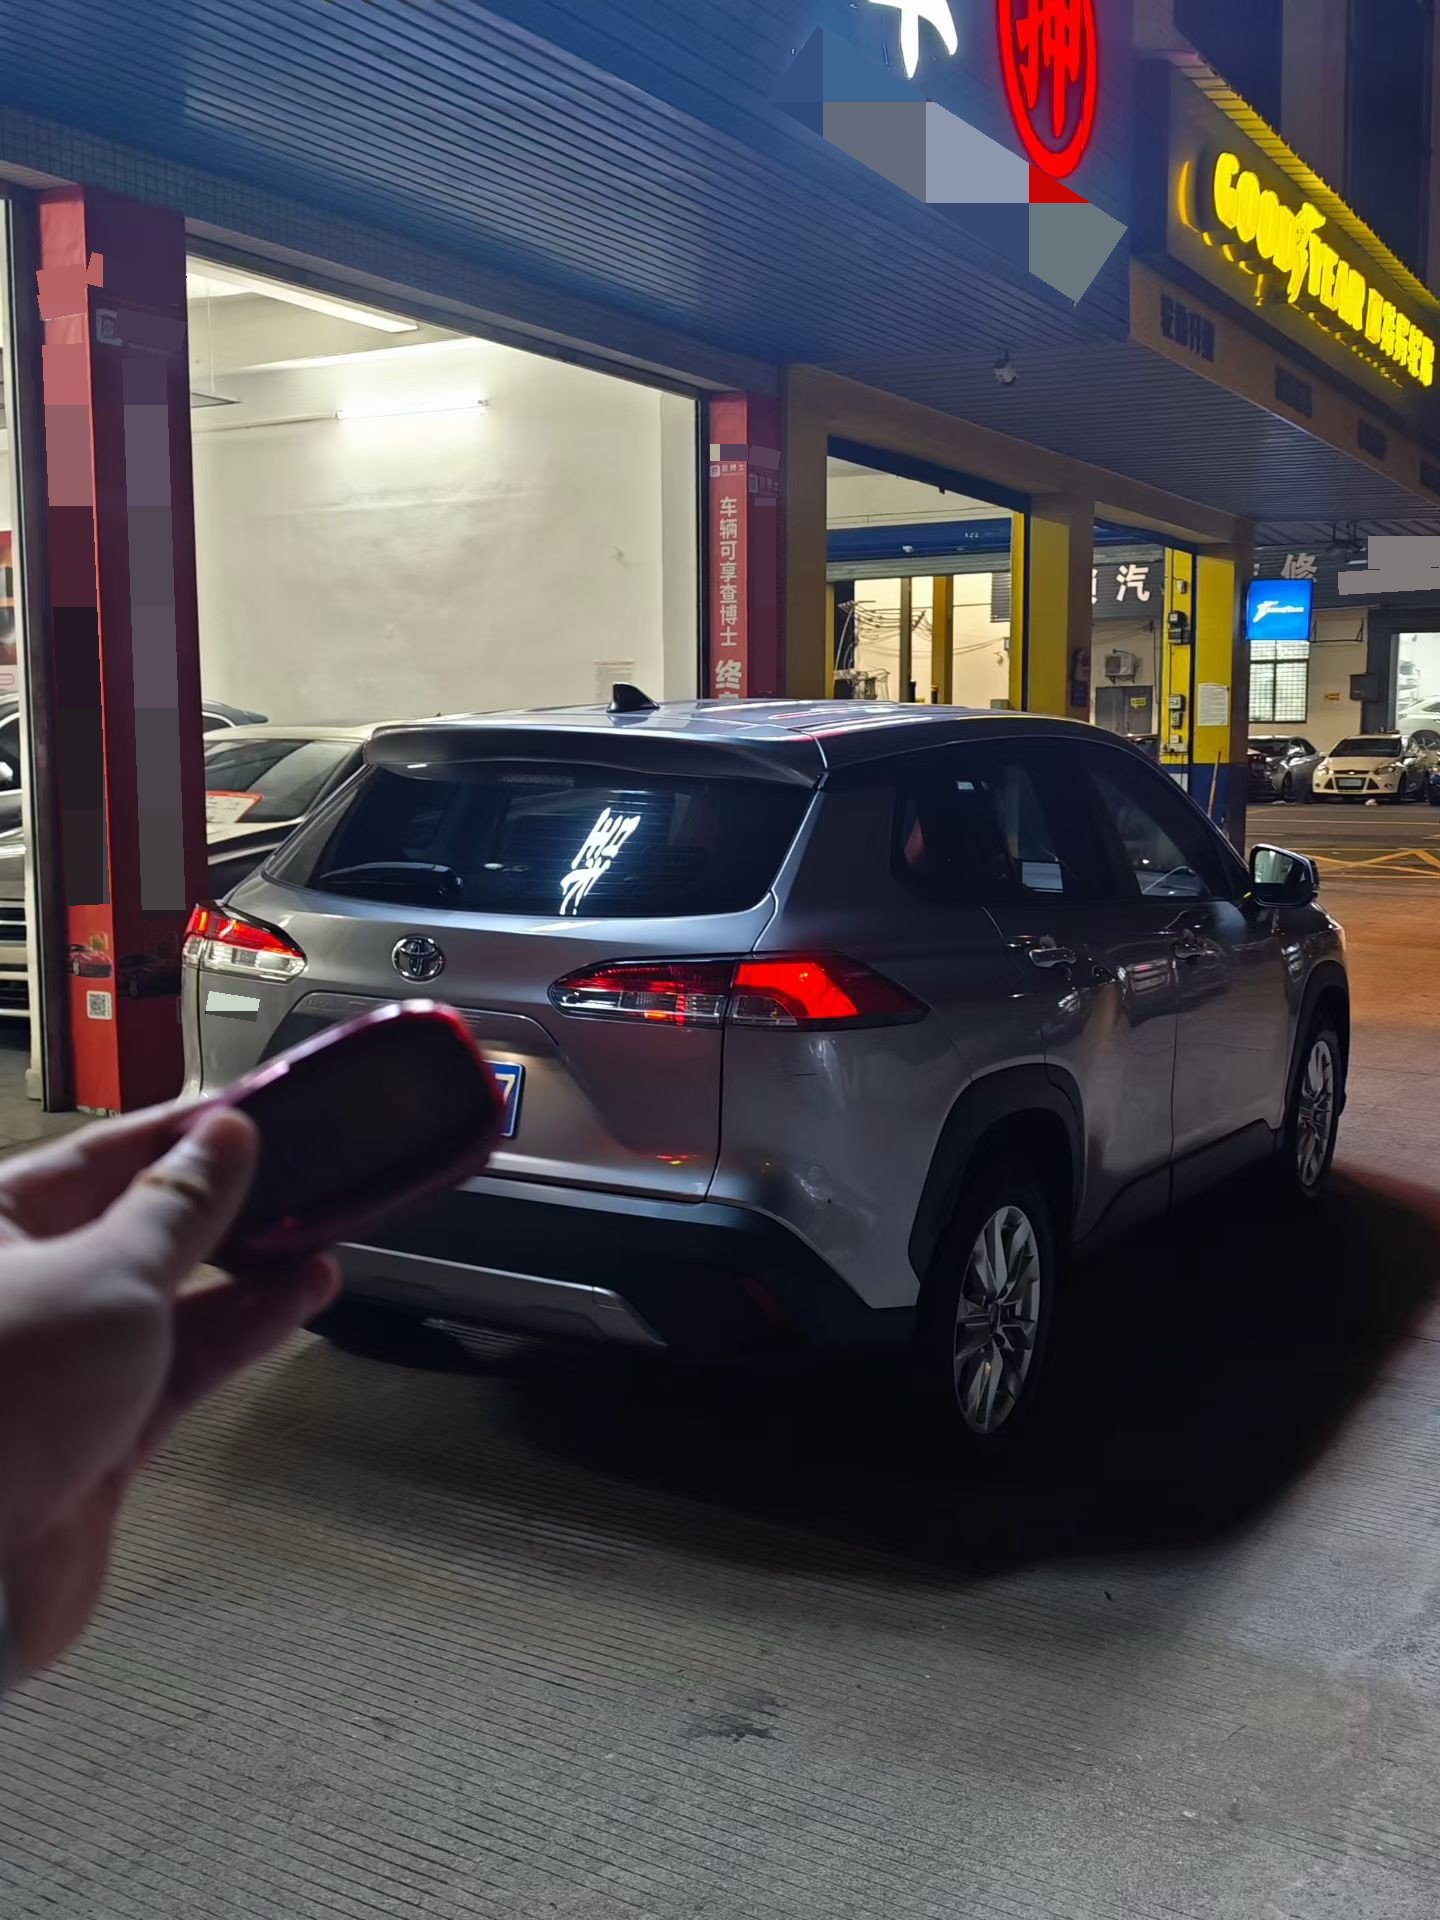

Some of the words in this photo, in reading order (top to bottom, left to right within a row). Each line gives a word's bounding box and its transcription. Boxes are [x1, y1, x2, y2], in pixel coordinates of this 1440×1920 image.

[719, 496, 738, 647] 车辆可享查博士
[715, 659, 742, 698] 终
